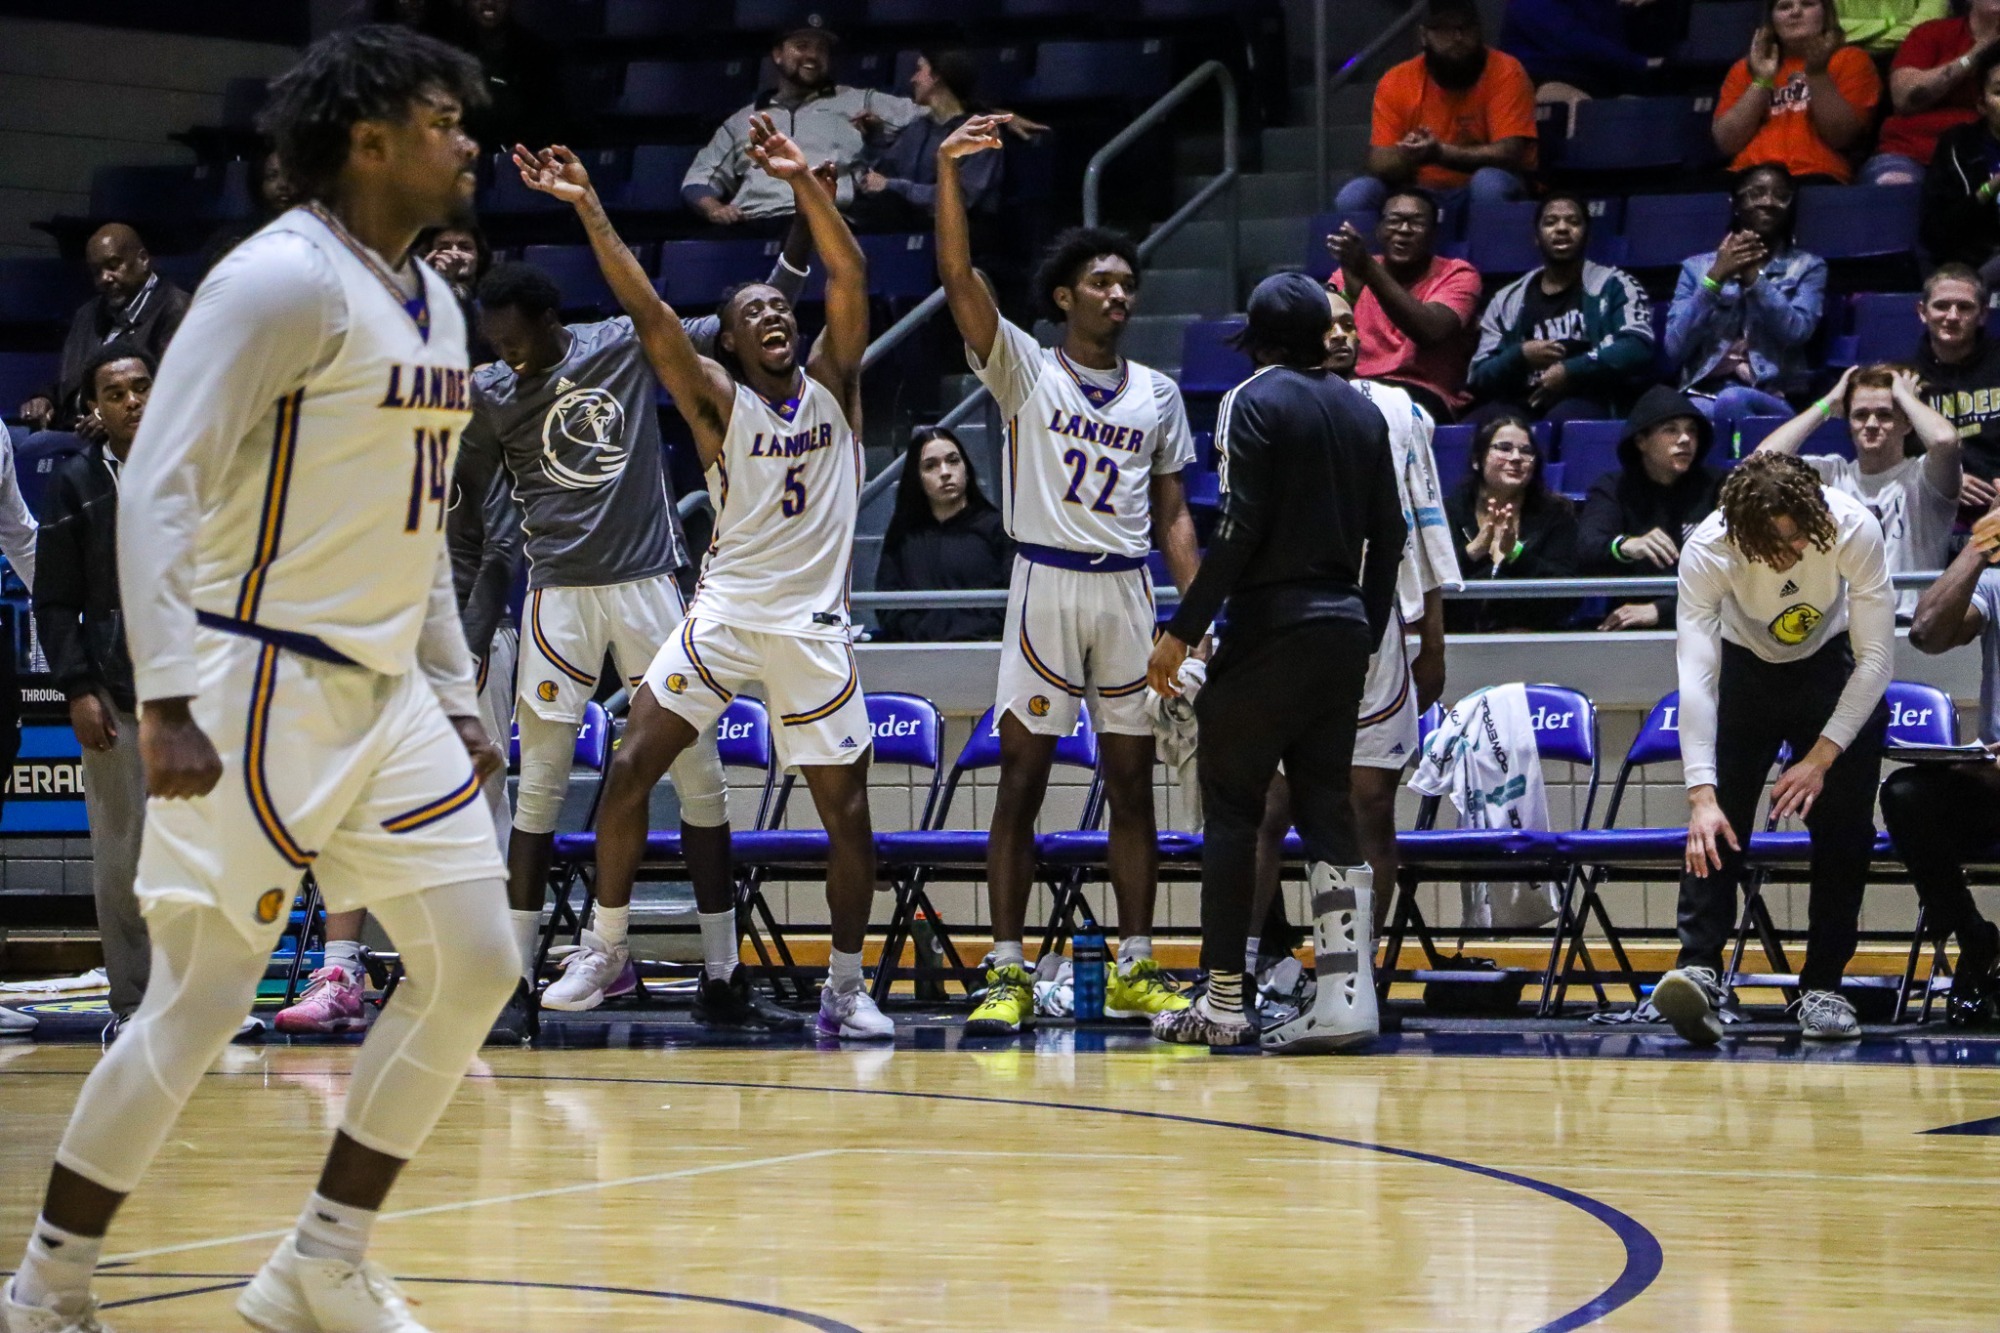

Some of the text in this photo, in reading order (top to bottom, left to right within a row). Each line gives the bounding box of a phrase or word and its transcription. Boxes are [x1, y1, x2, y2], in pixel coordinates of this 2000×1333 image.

[378, 364, 472, 412] LANDE
[749, 422, 832, 458] LANDER
[1047, 408, 1145, 455] LANDER
[403, 425, 451, 534] 14
[782, 462, 809, 519] 5
[1062, 447, 1119, 516] 22
